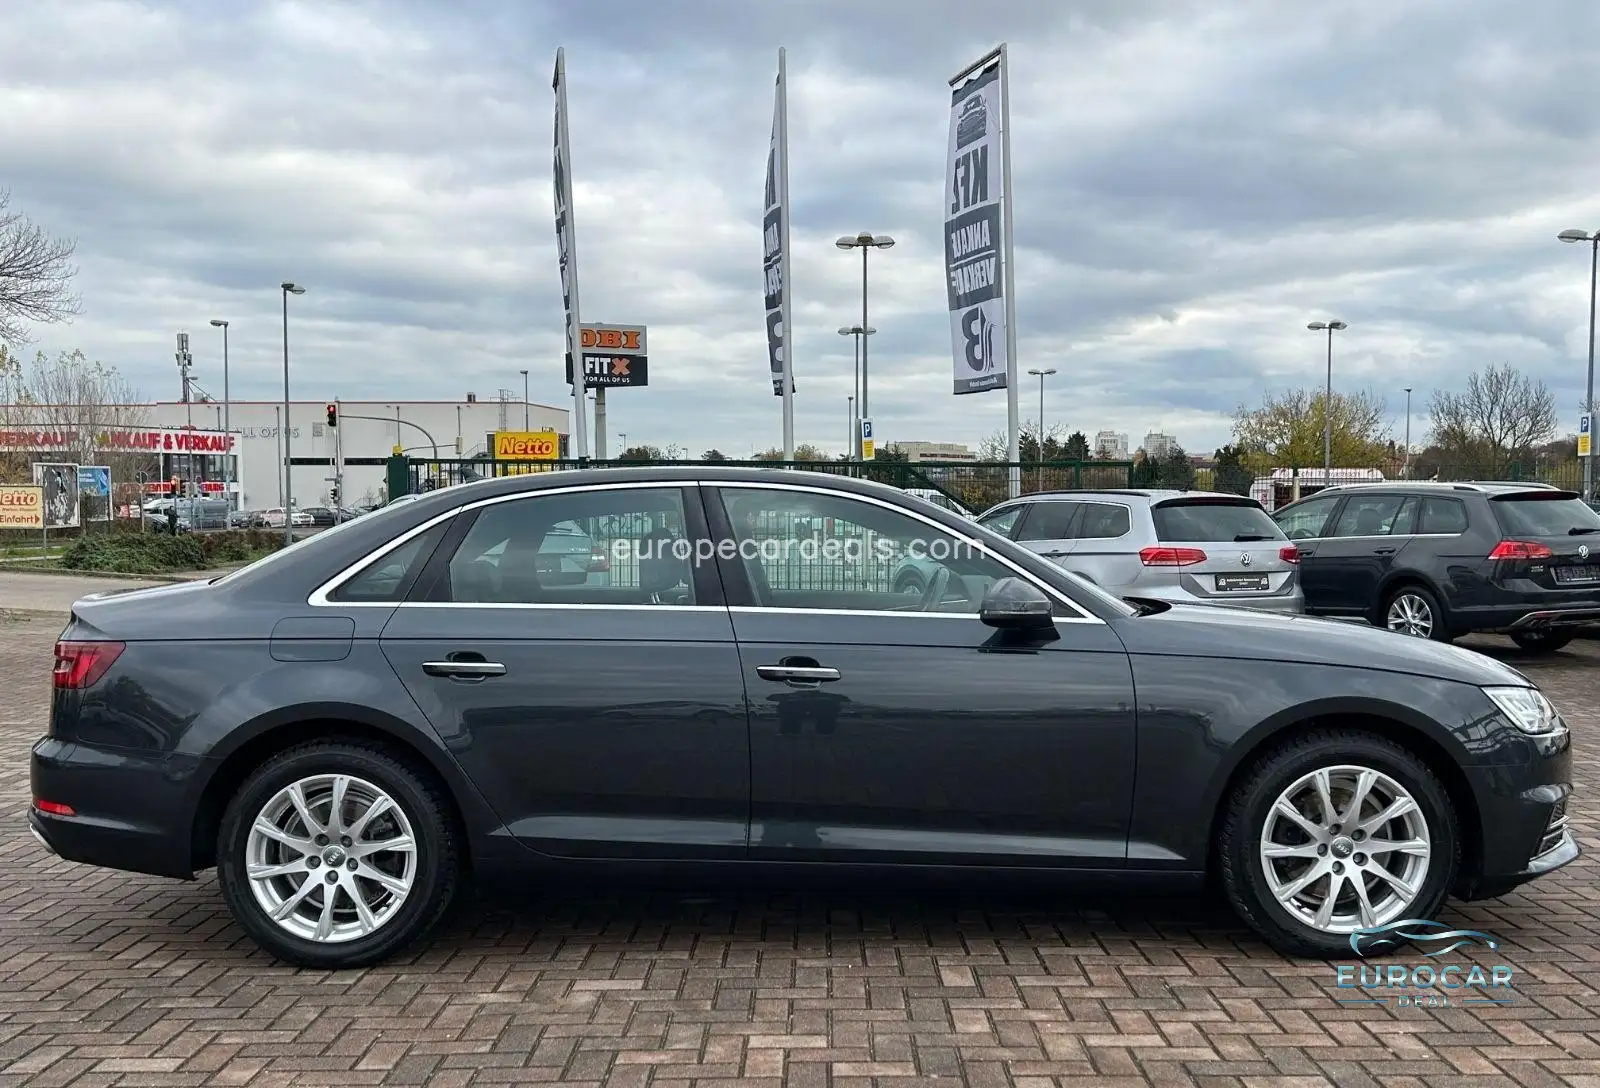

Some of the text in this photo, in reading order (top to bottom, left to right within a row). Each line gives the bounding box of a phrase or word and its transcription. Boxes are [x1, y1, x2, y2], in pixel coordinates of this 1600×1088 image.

[865, 423, 870, 436] P
[1582, 418, 1588, 431] P
[163, 434, 173, 450] &
[175, 433, 235, 451] VERKAUF
[500, 437, 554, 455] Netto
[0, 490, 38, 506] etto
[0, 515, 34, 523] Einfahrt
